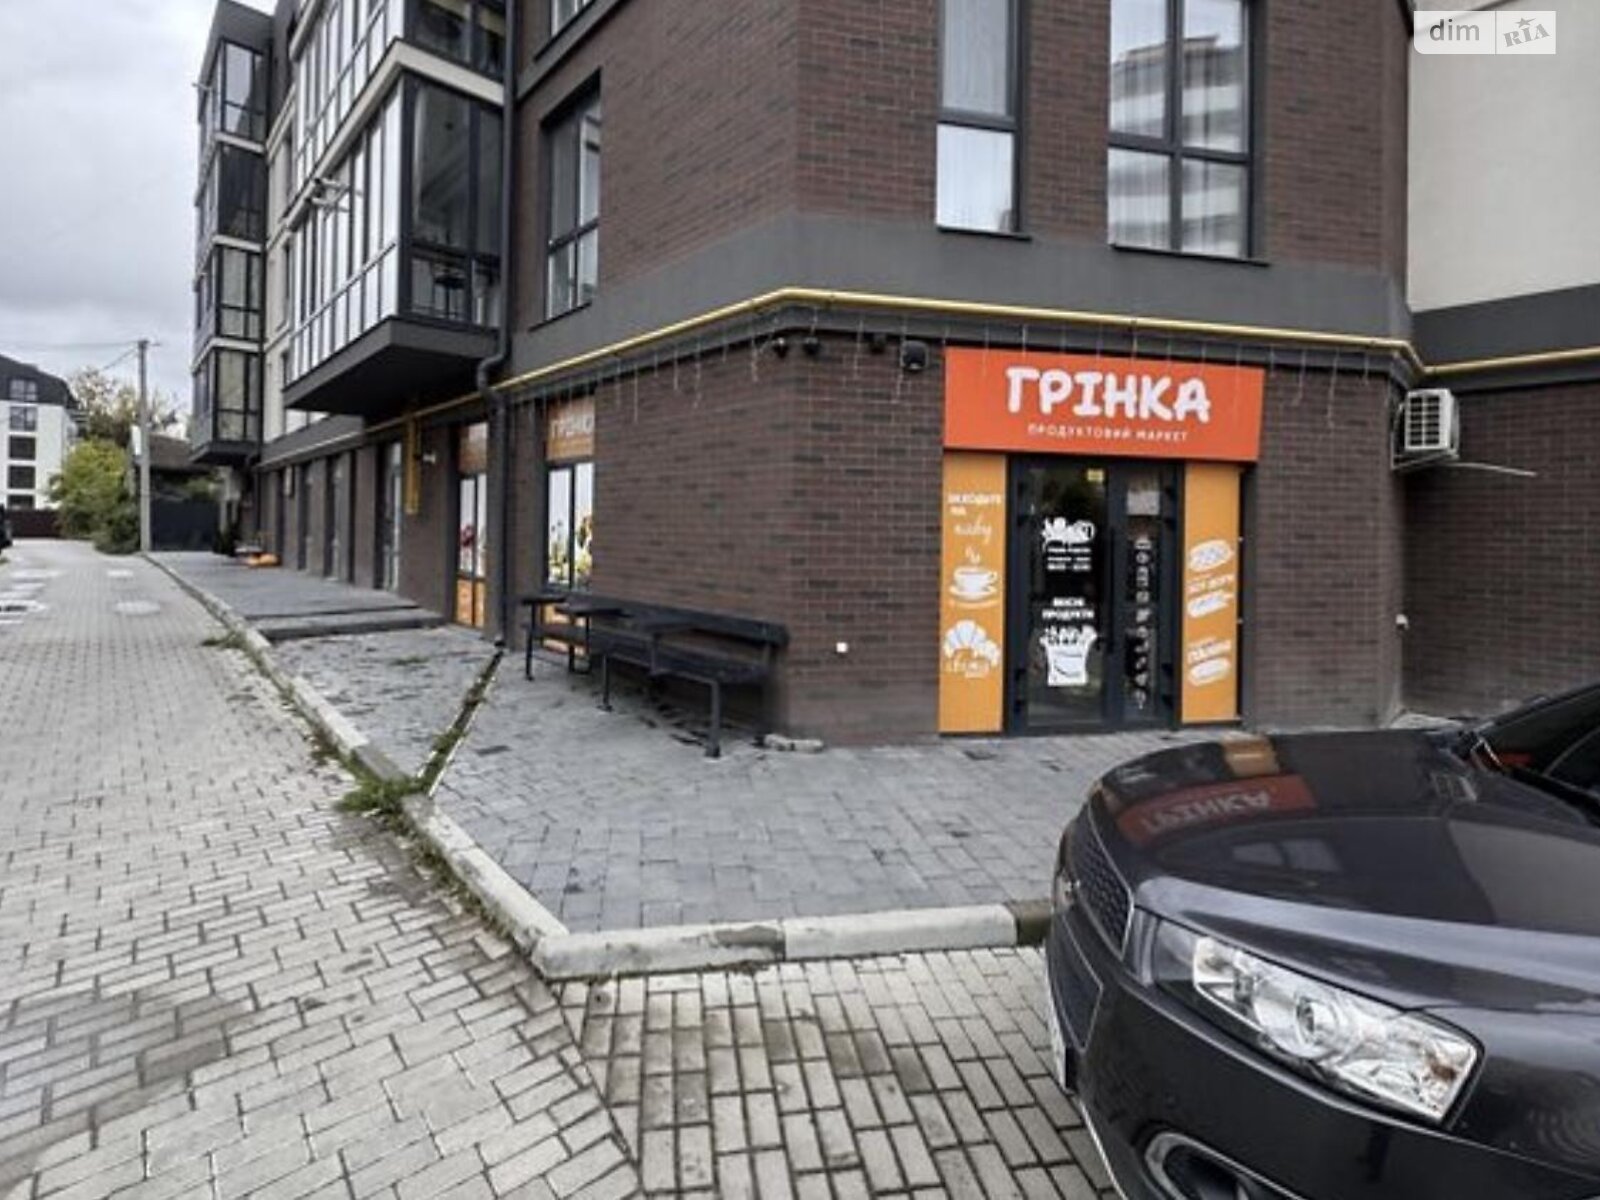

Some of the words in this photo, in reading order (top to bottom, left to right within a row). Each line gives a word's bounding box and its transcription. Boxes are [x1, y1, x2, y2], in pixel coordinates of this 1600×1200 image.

[1005, 366, 1211, 424] ГРІНКА
[1027, 423, 1131, 440] ПРОДУКТОВИЙ
[1136, 429, 1188, 443] МАРКЕТ
